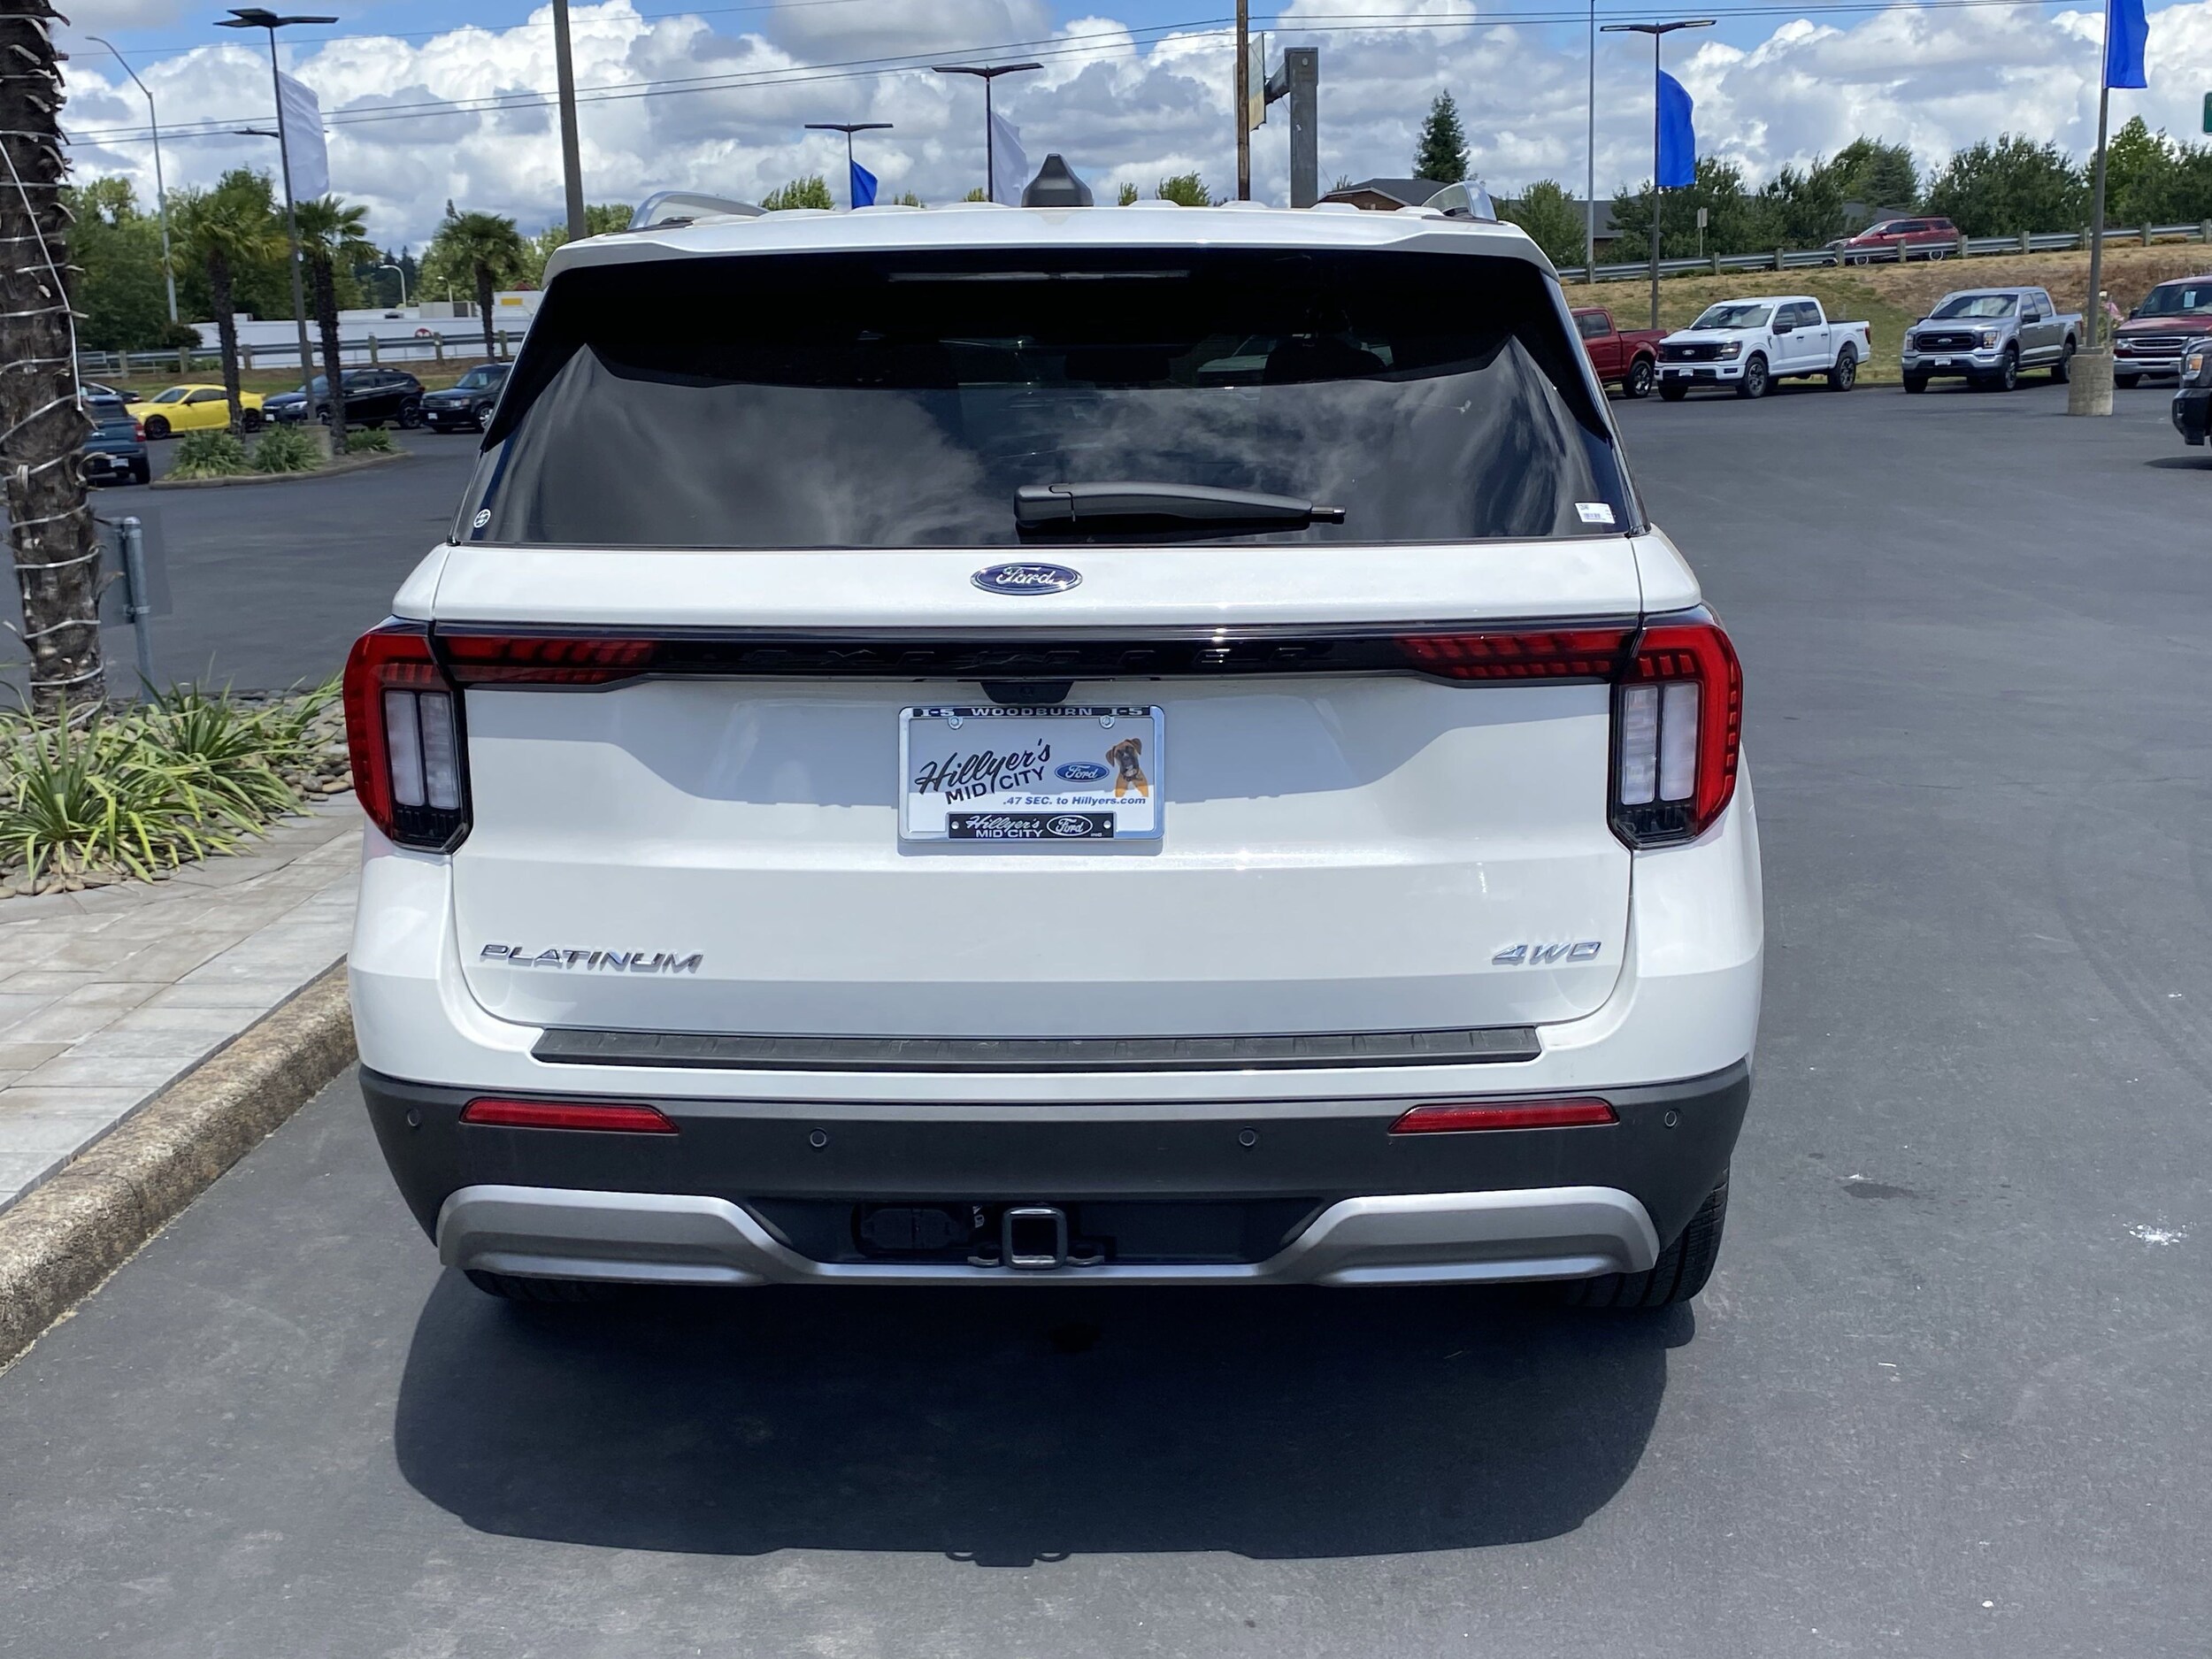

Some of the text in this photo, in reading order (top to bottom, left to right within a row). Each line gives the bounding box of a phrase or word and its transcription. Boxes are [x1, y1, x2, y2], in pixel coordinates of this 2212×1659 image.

[920, 708, 1145, 717] I-5 WOODBURN I-5
[914, 738, 1051, 795] Hillyer's
[945, 765, 1046, 805] MID CITY
[1025, 796, 1053, 805] SEC.
[1071, 796, 1147, 807] Hillyers.com
[965, 815, 1041, 833] Hillyer's
[976, 829, 1044, 838] MID CITY
[480, 943, 704, 973] PLATINUM
[1492, 941, 1601, 965] 4WD
